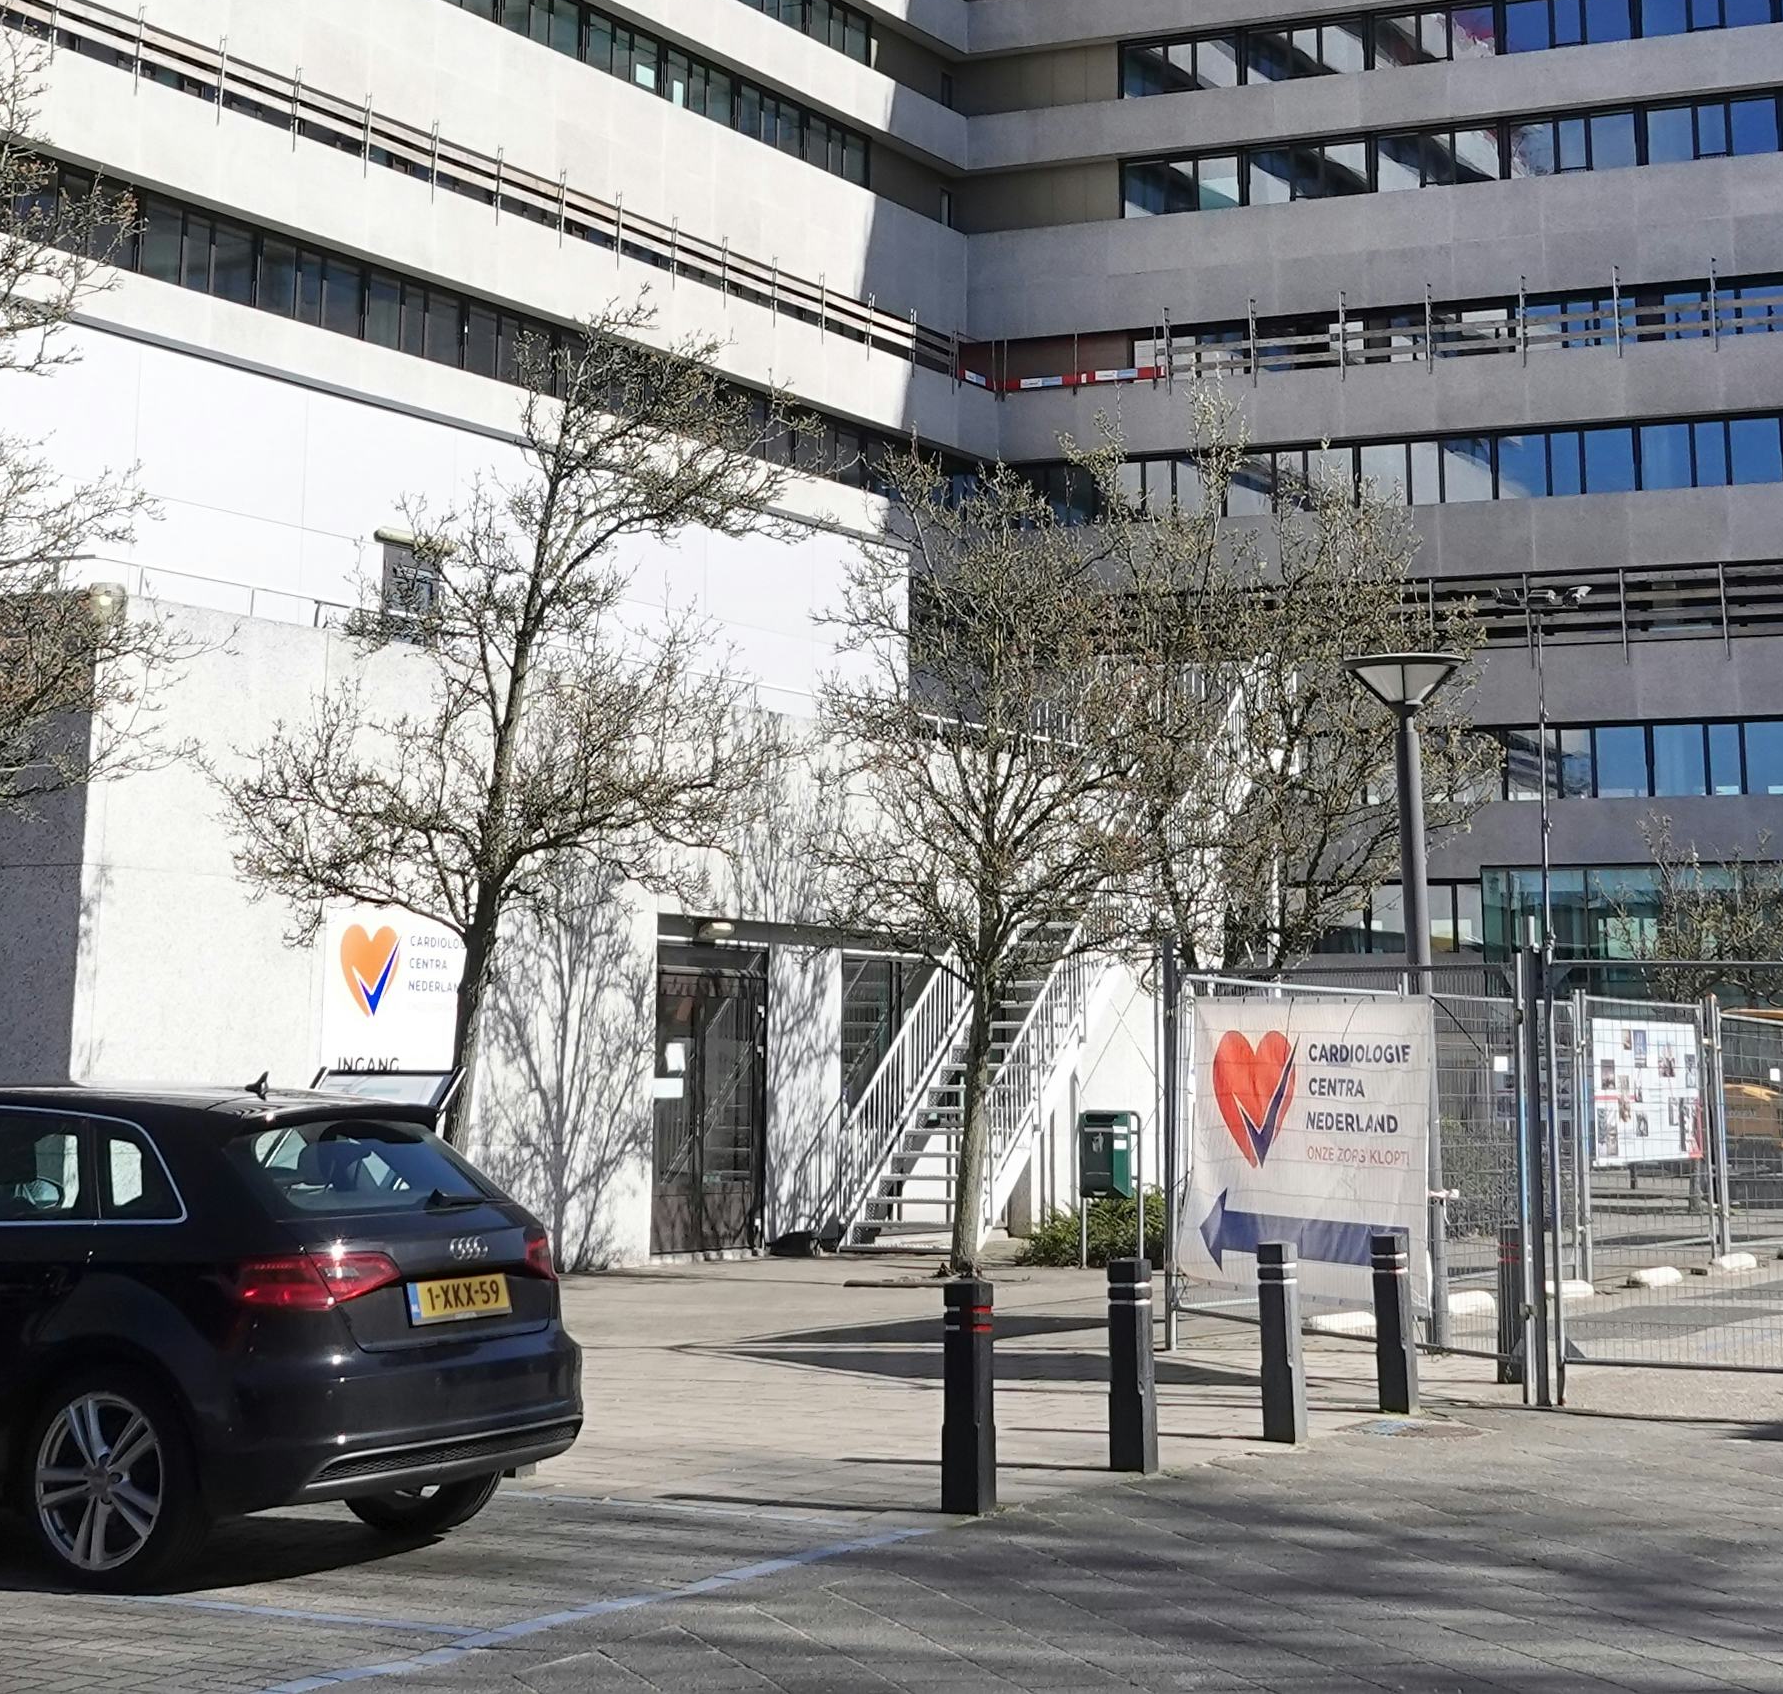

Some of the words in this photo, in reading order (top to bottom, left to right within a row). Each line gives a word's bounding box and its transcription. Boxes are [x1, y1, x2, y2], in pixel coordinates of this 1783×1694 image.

[409, 957, 448, 970] CENTRA
[1308, 1043, 1411, 1063] CARDIOLOGIE
[1308, 1077, 1365, 1098] CENTRA
[1306, 1110, 1399, 1134] NEDERLAND
[1307, 1145, 1334, 1161] ONZE
[1337, 1147, 1366, 1164] ZORG
[427, 1279, 500, 1311] 1-XKX-59
